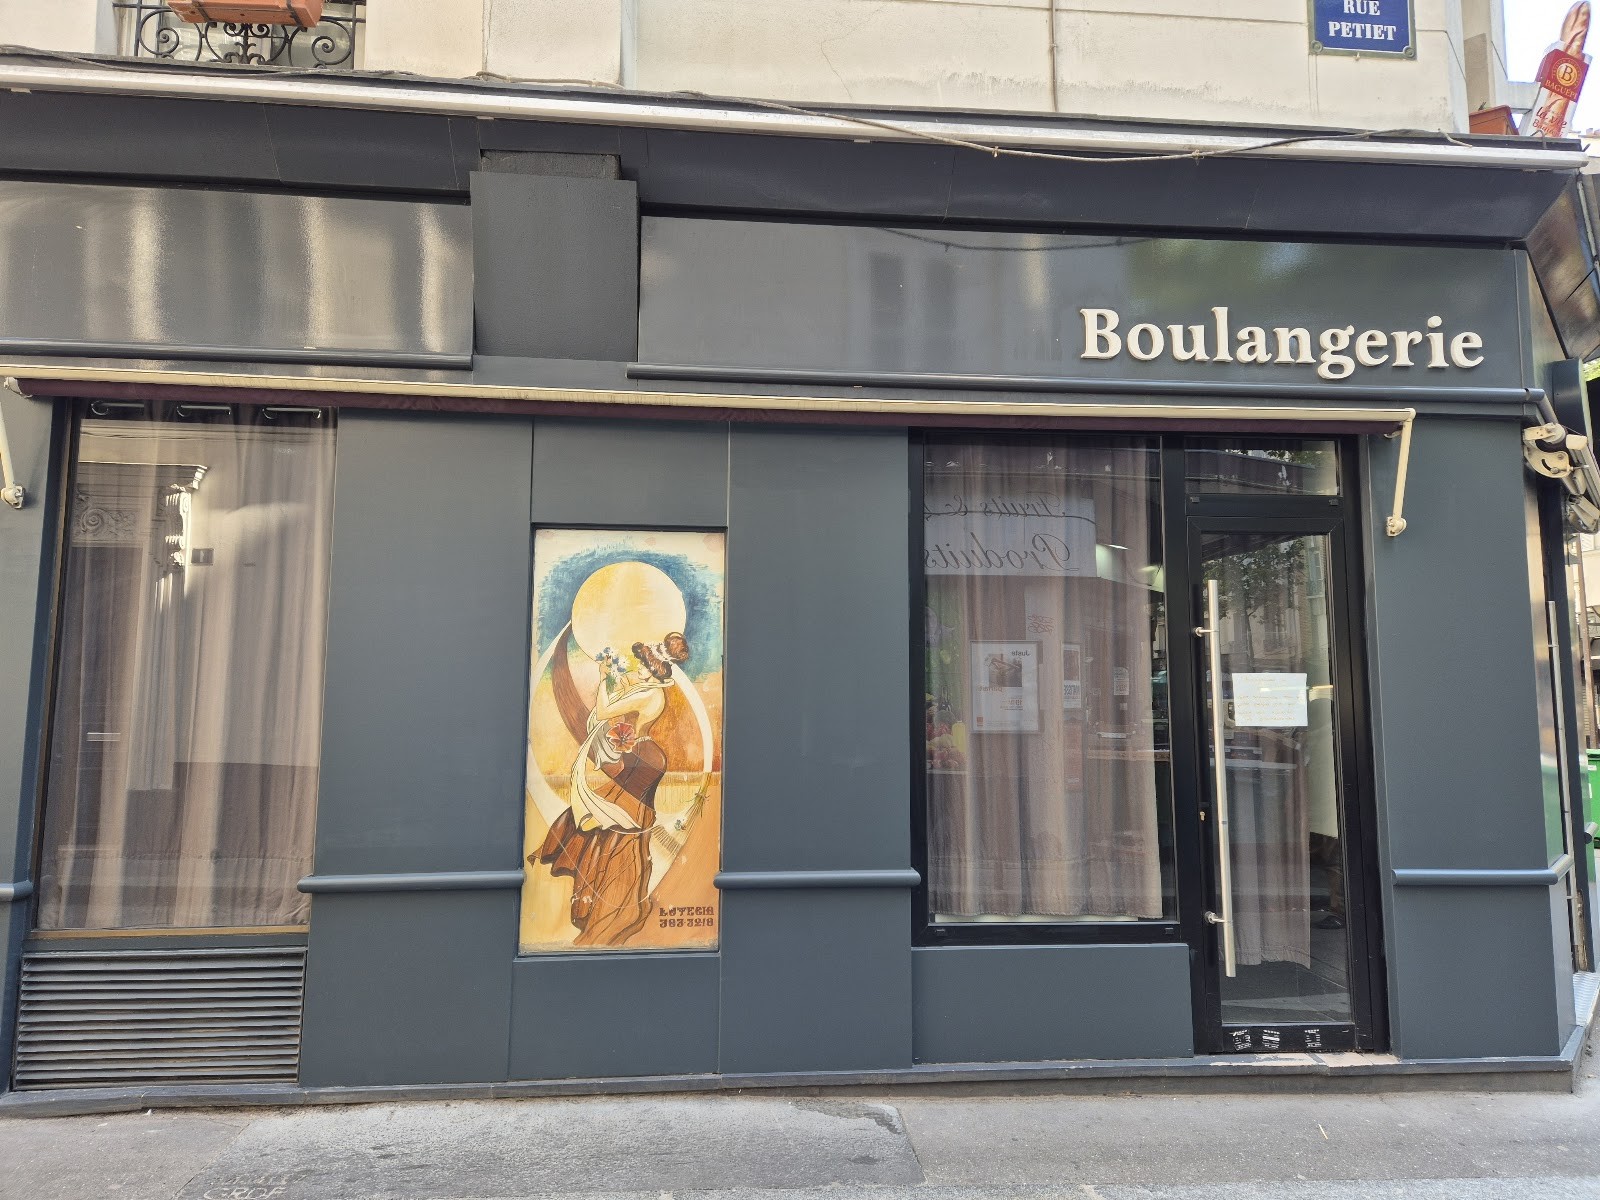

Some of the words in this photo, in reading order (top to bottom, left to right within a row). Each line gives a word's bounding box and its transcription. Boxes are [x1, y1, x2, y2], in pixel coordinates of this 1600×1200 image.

[1343, 0, 1381, 16] RUE
[1328, 21, 1397, 40] PETIET
[1561, 64, 1573, 81] B
[1079, 306, 1485, 380] Boulangerie
